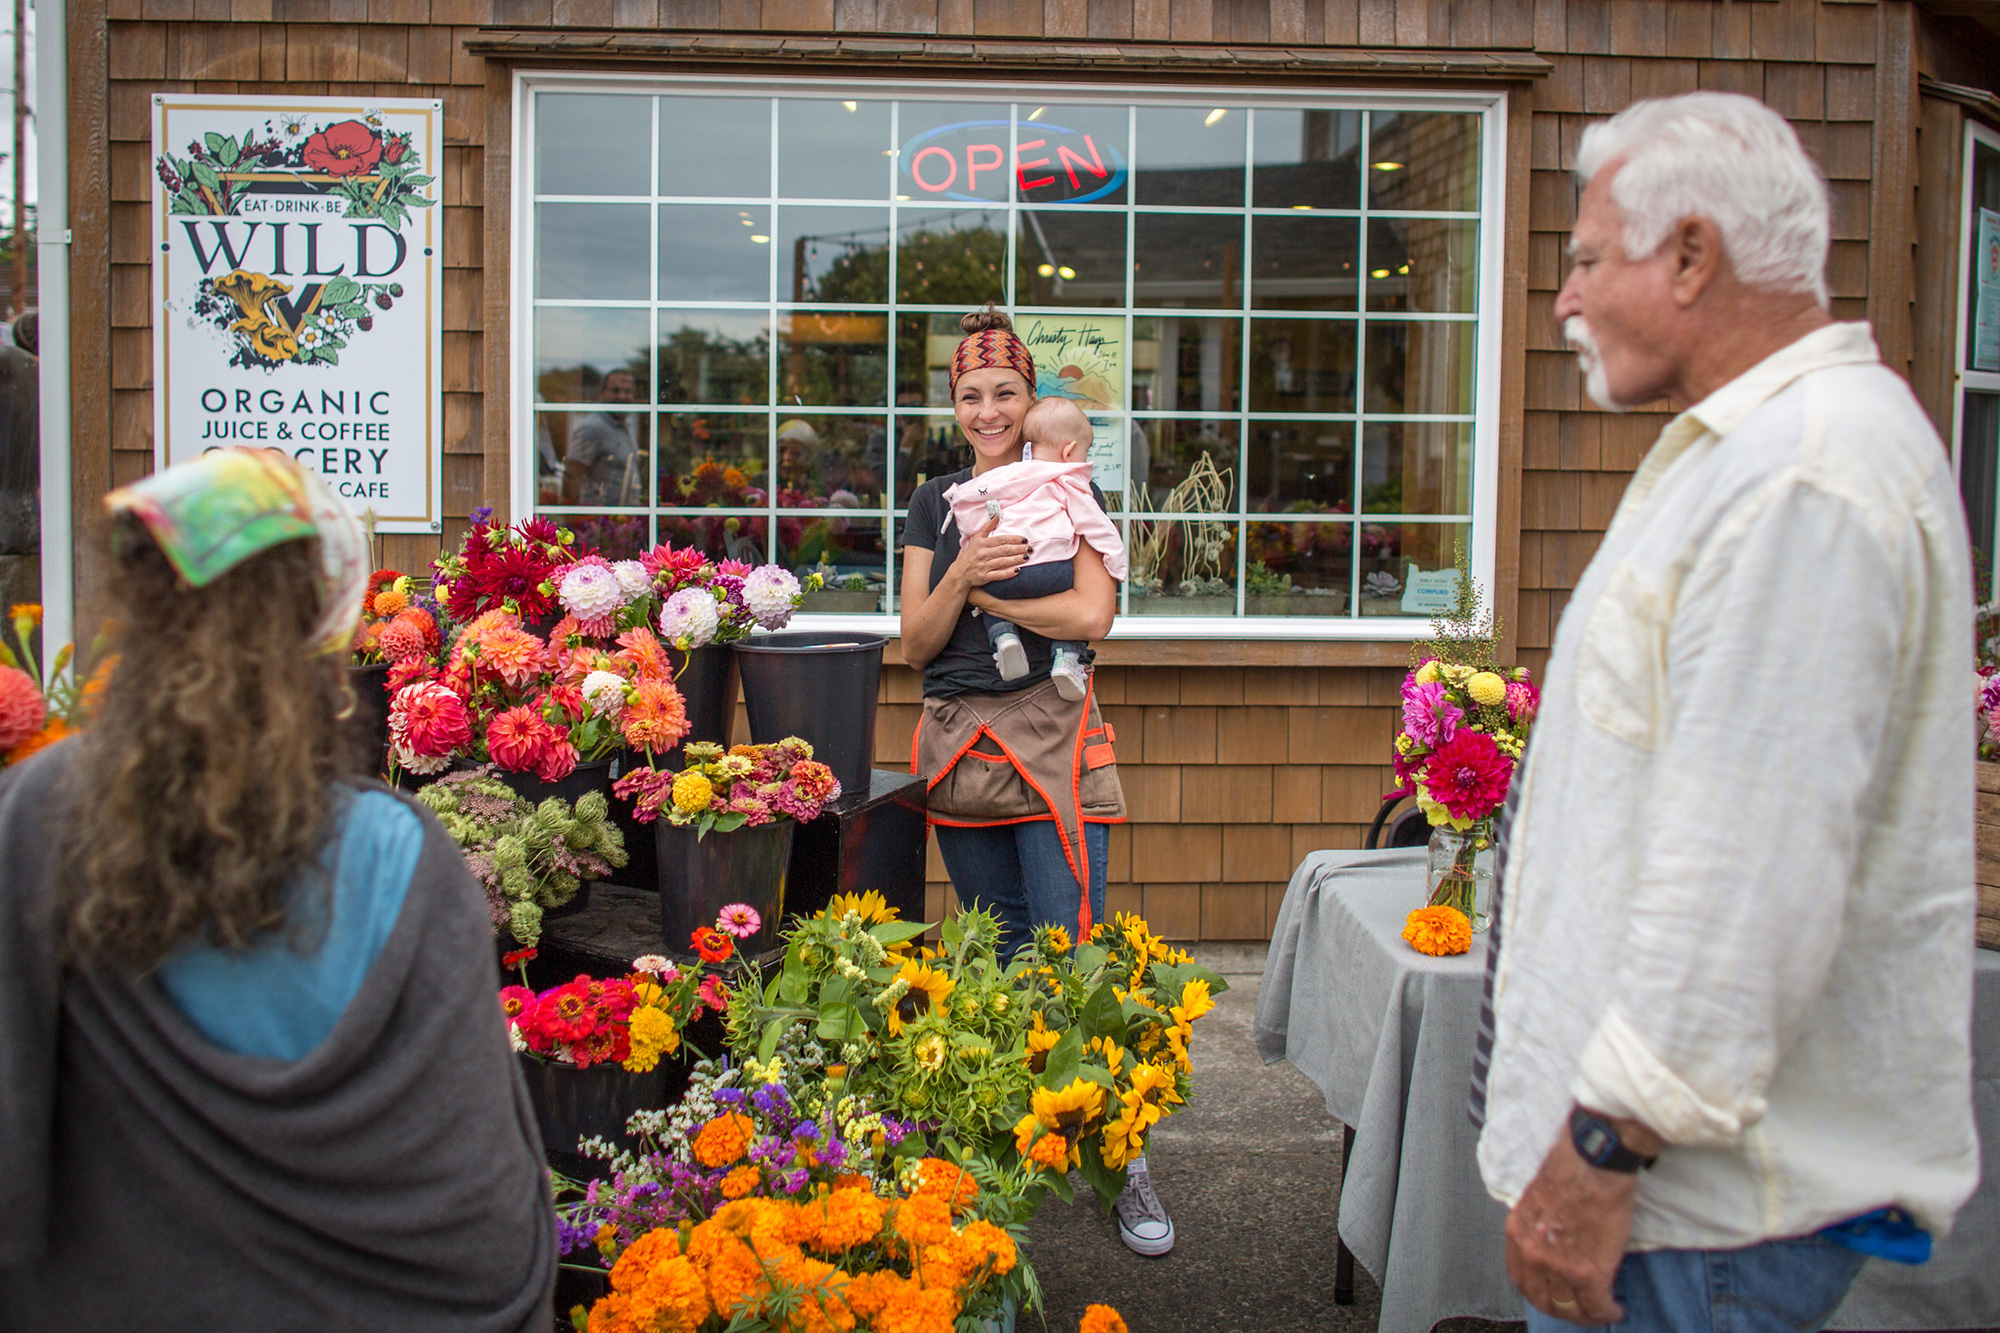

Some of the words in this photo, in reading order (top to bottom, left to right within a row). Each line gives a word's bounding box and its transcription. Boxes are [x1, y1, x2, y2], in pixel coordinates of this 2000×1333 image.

[912, 134, 1108, 193] OPEN
[180, 221, 406, 277] WILD
[1026, 319, 1077, 357] Christy
[200, 388, 390, 415] ORGANIC
[201, 420, 268, 440] JUICE
[276, 421, 293, 440] &
[300, 422, 390, 441] COFFEE
[201, 445, 389, 474] CERY
[339, 481, 389, 499] CAFE
